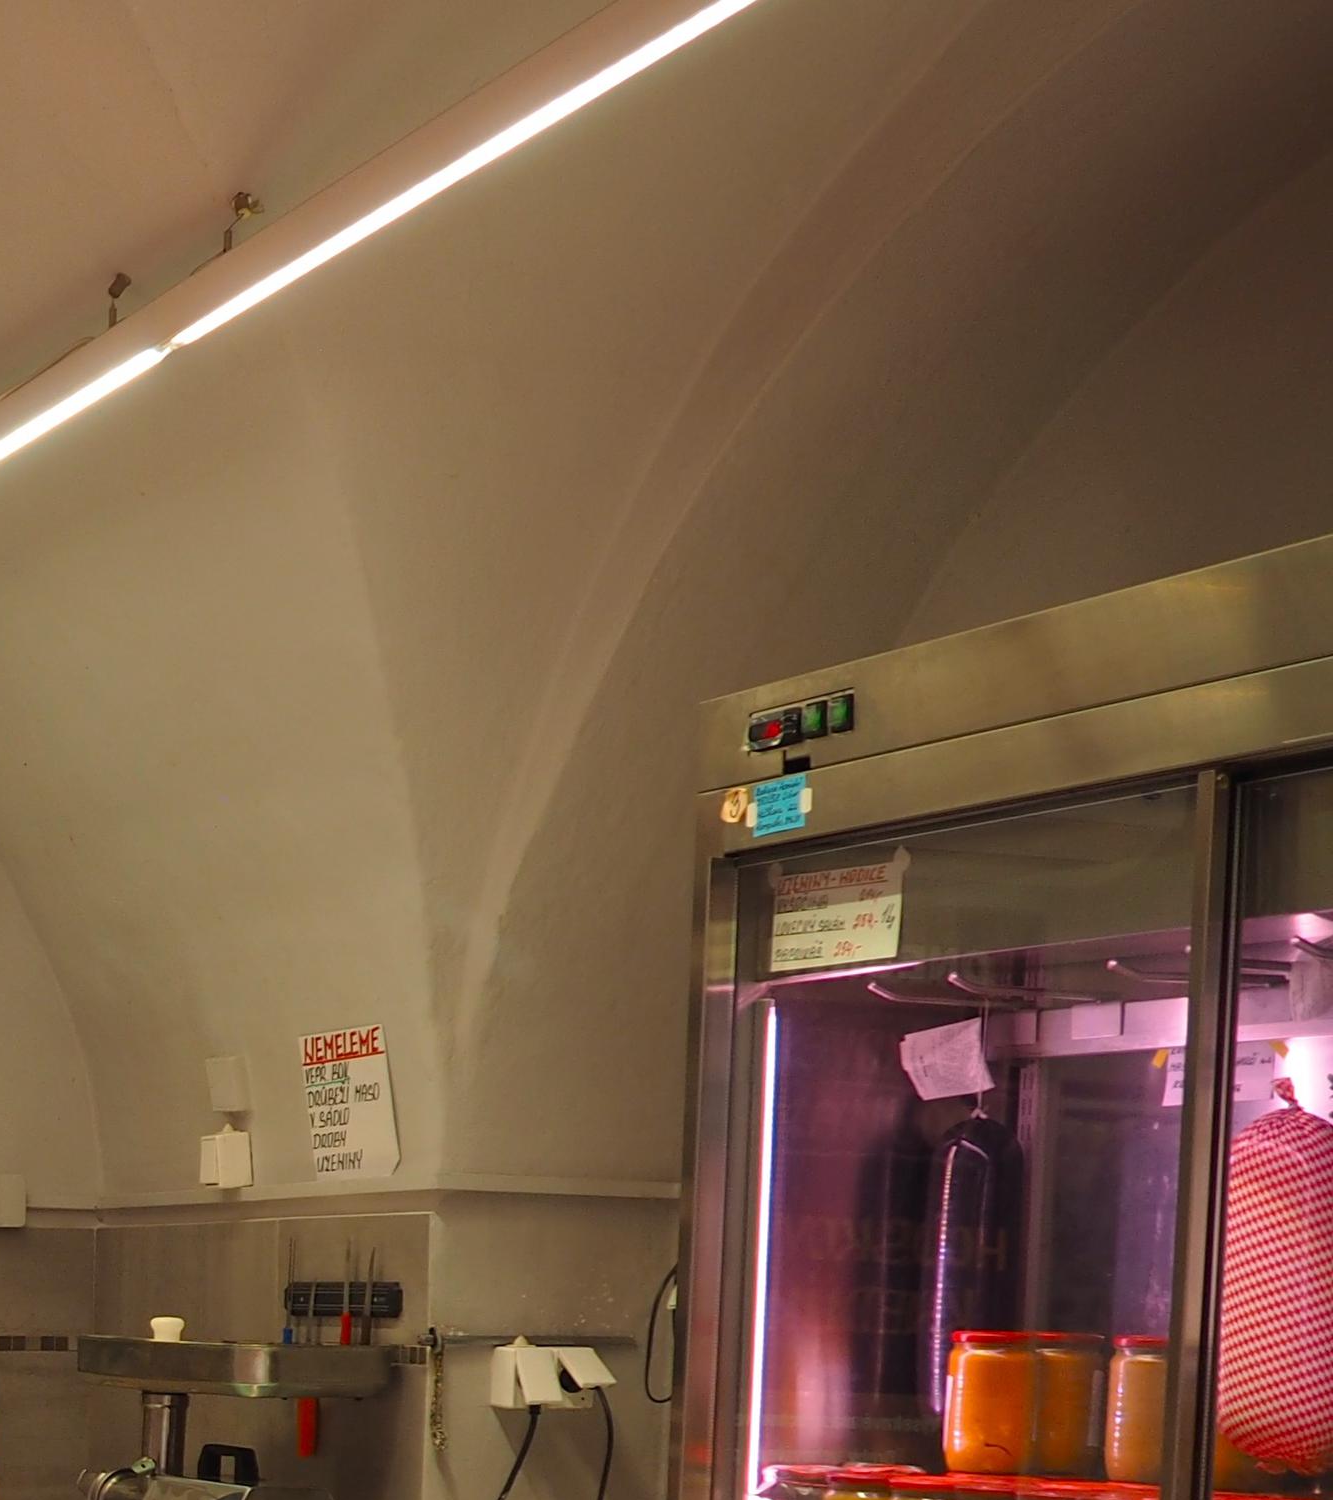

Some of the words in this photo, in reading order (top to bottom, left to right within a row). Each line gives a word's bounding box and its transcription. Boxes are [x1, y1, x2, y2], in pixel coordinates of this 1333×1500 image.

[303, 1026, 382, 1063] NEMELEME
[354, 1082, 381, 1103] MASO
[312, 1129, 348, 1150] DROBY
